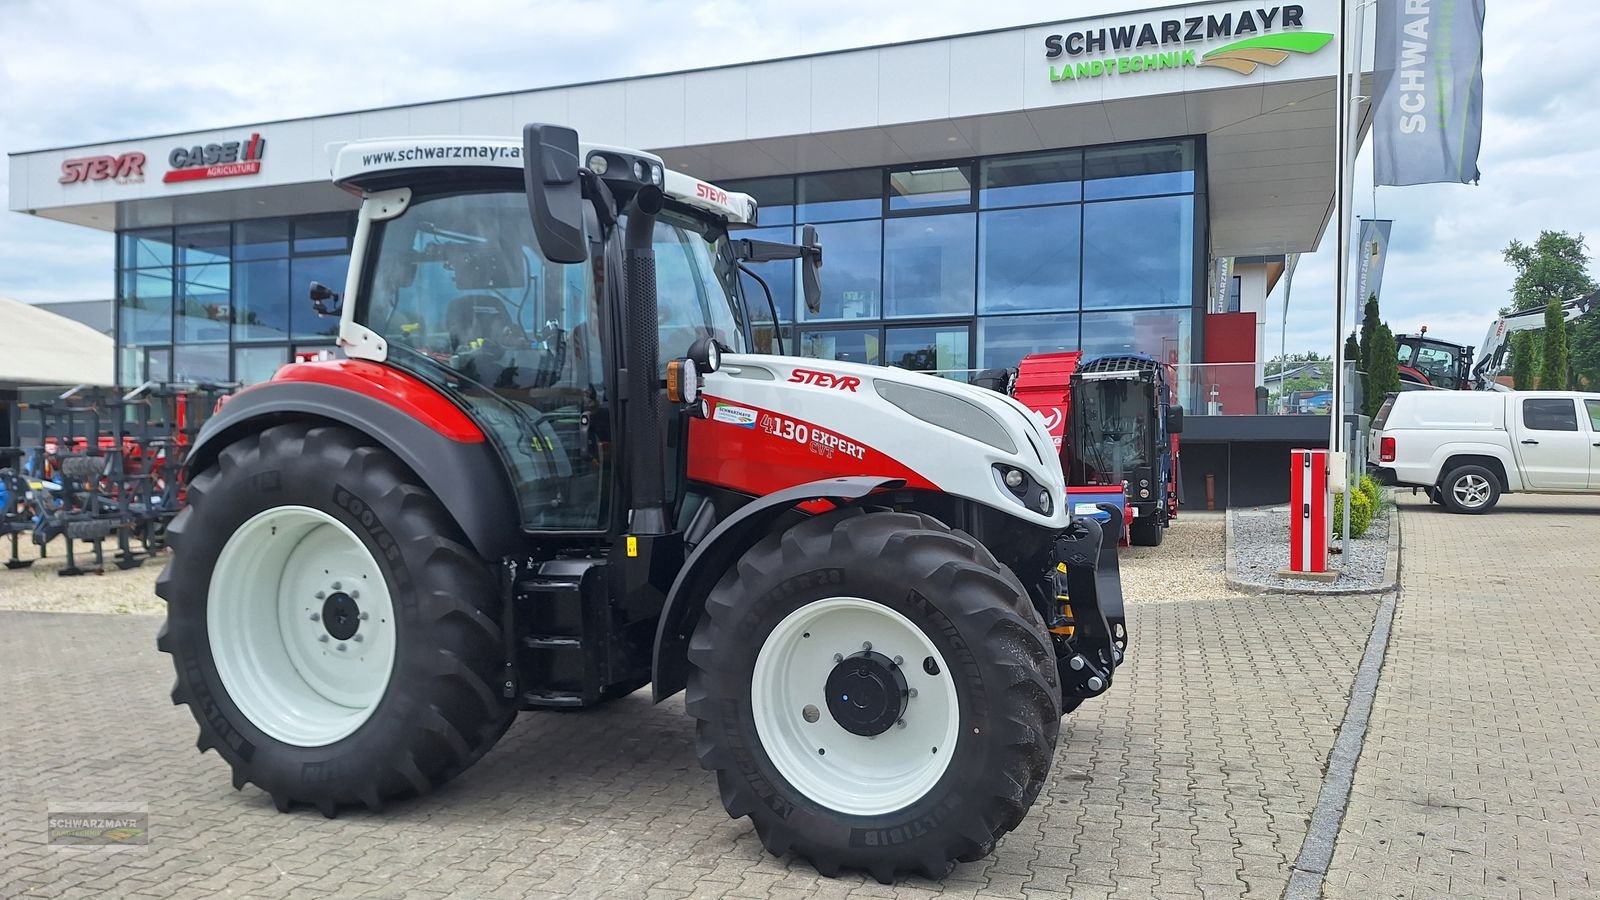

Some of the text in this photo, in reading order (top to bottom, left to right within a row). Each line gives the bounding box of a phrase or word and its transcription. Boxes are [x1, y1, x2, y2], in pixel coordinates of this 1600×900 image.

[1045, 4, 1305, 58] SCHWARZMAYR
[1049, 49, 1197, 81] LANDTECHNIK
[58, 152, 146, 184] STEYR
[168, 141, 240, 169] CASE
[362, 146, 524, 166] www.schwarzmayr.a
[206, 163, 257, 177] AGRICULTURE
[696, 183, 728, 206] STEYR
[787, 367, 862, 393] STEYR
[760, 413, 866, 460] 4130 EXPERT
[809, 441, 835, 459] CVT
